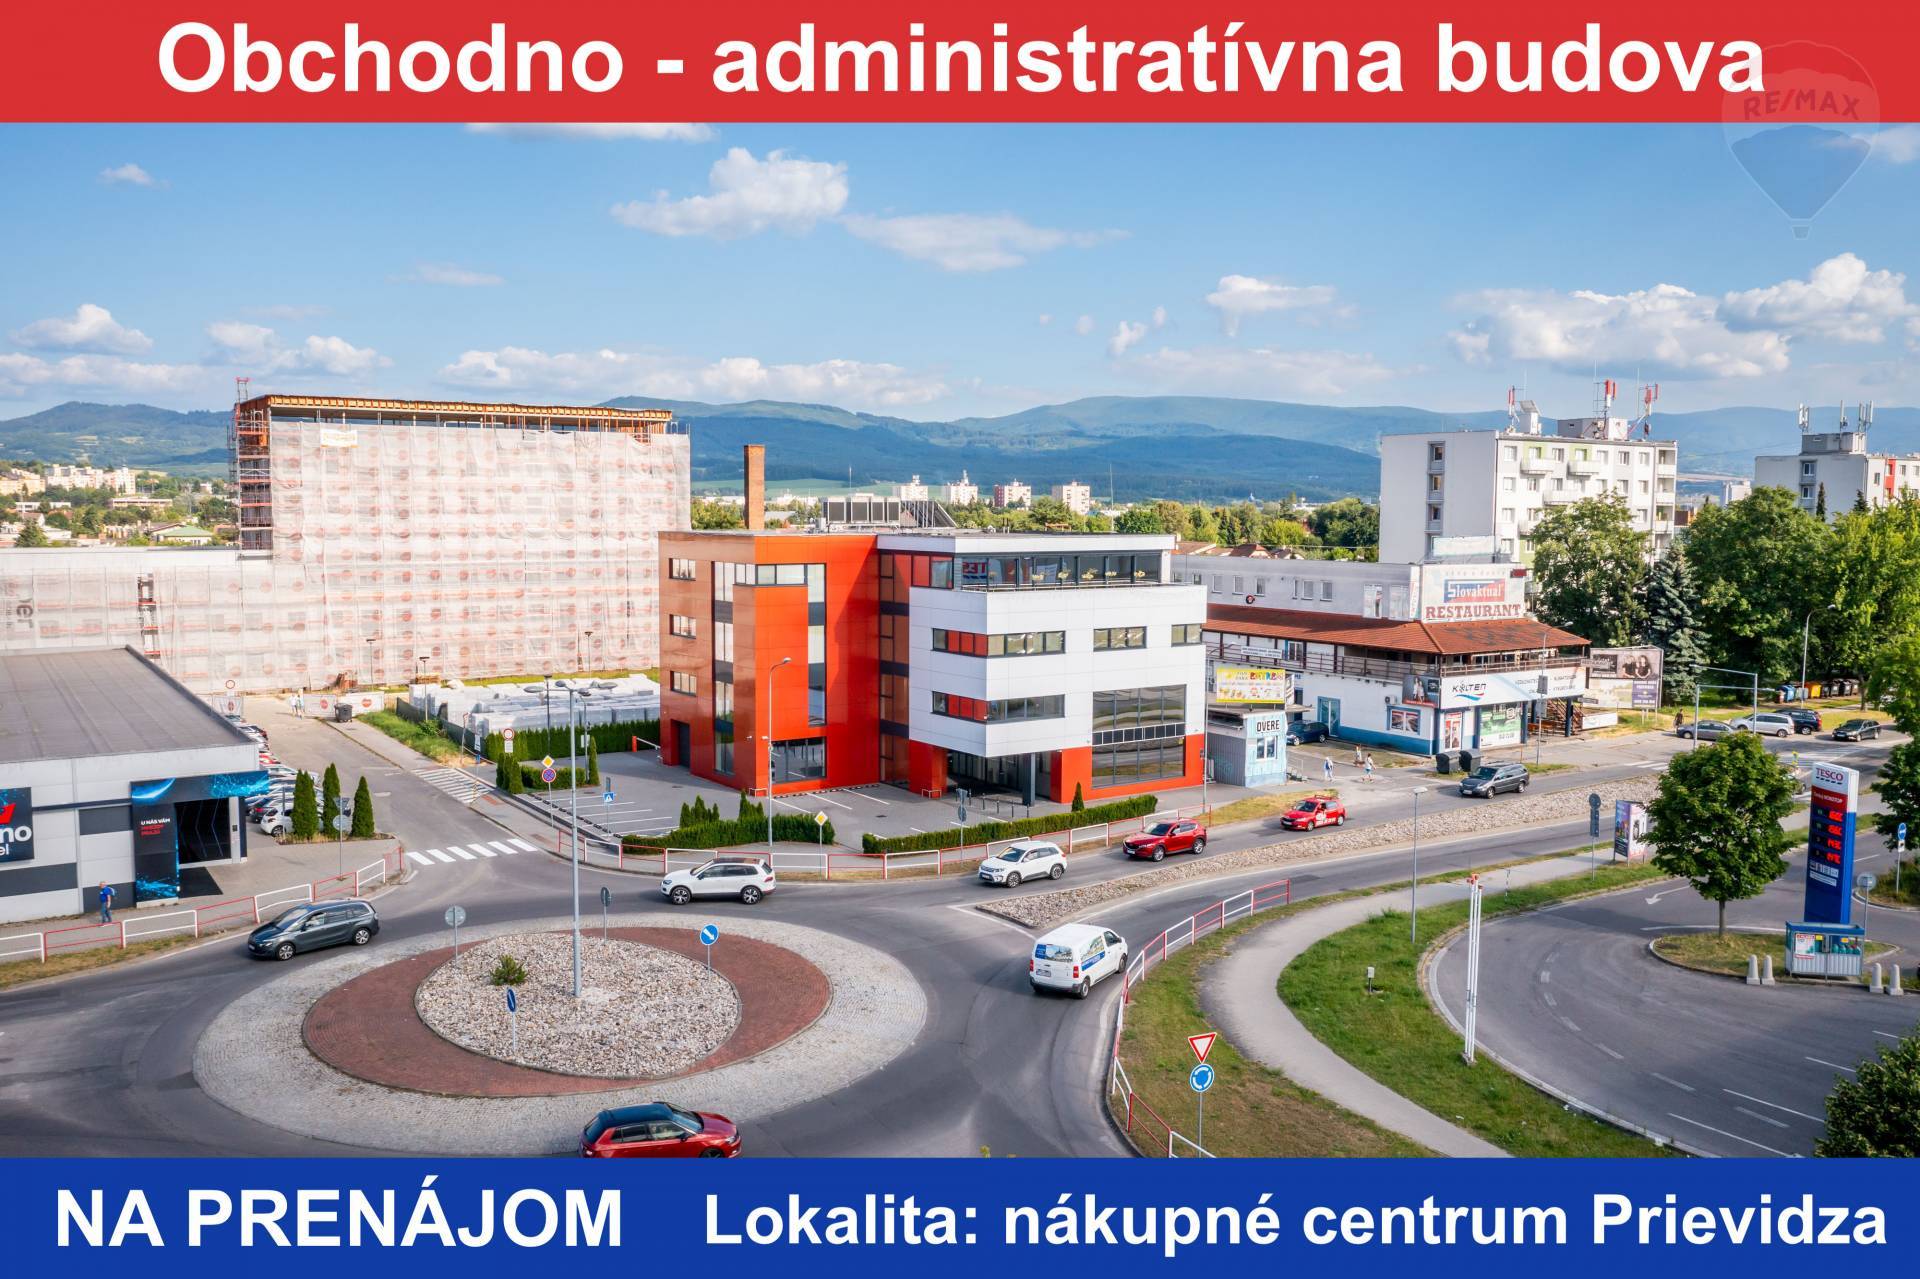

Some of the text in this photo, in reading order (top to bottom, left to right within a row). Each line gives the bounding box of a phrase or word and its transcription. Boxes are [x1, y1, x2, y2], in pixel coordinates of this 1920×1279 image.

[1448, 580, 1502, 598] Slovaktual
[1425, 603, 1521, 619] RESTAURANT
[1815, 767, 1844, 781] TESCO
